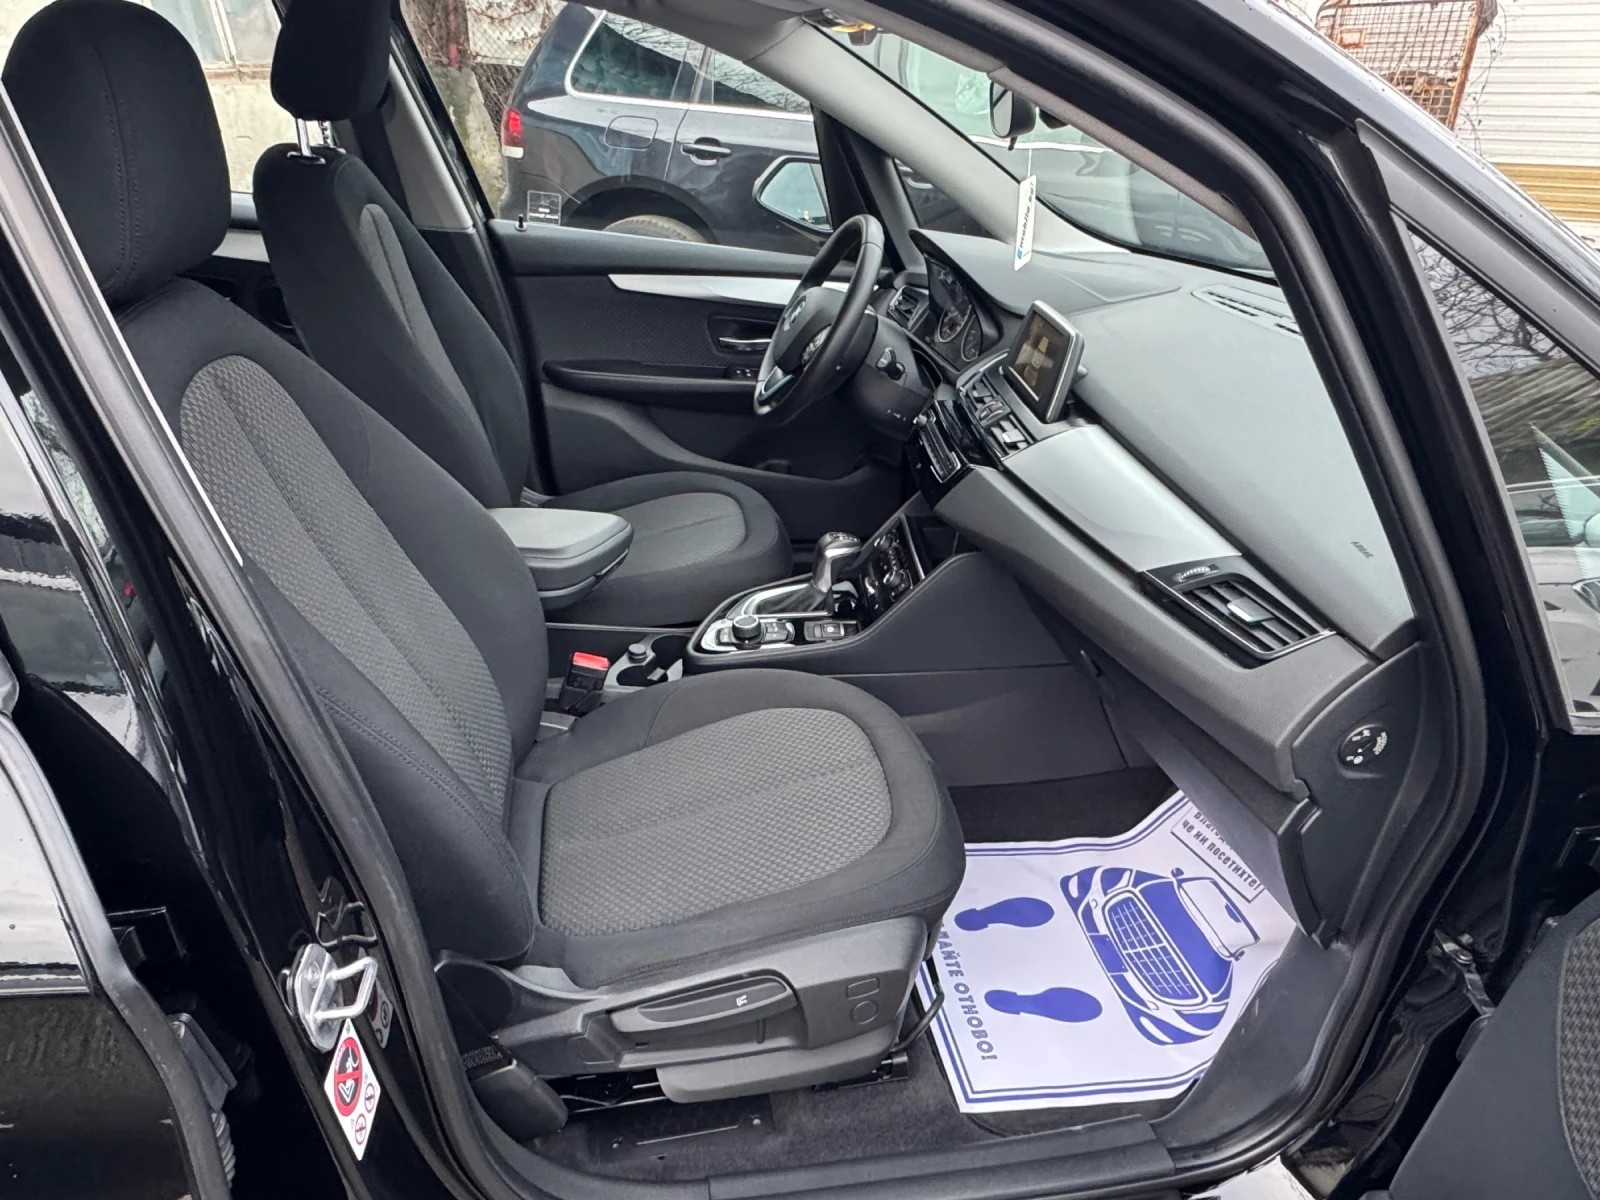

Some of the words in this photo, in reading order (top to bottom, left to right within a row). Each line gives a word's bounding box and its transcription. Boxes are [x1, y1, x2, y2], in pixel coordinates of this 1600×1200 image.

[1182, 819, 1195, 834] че
[1193, 830, 1209, 846] ни
[1206, 842, 1263, 891] посетихте!
[953, 982, 998, 1060] ОТНОВО!
